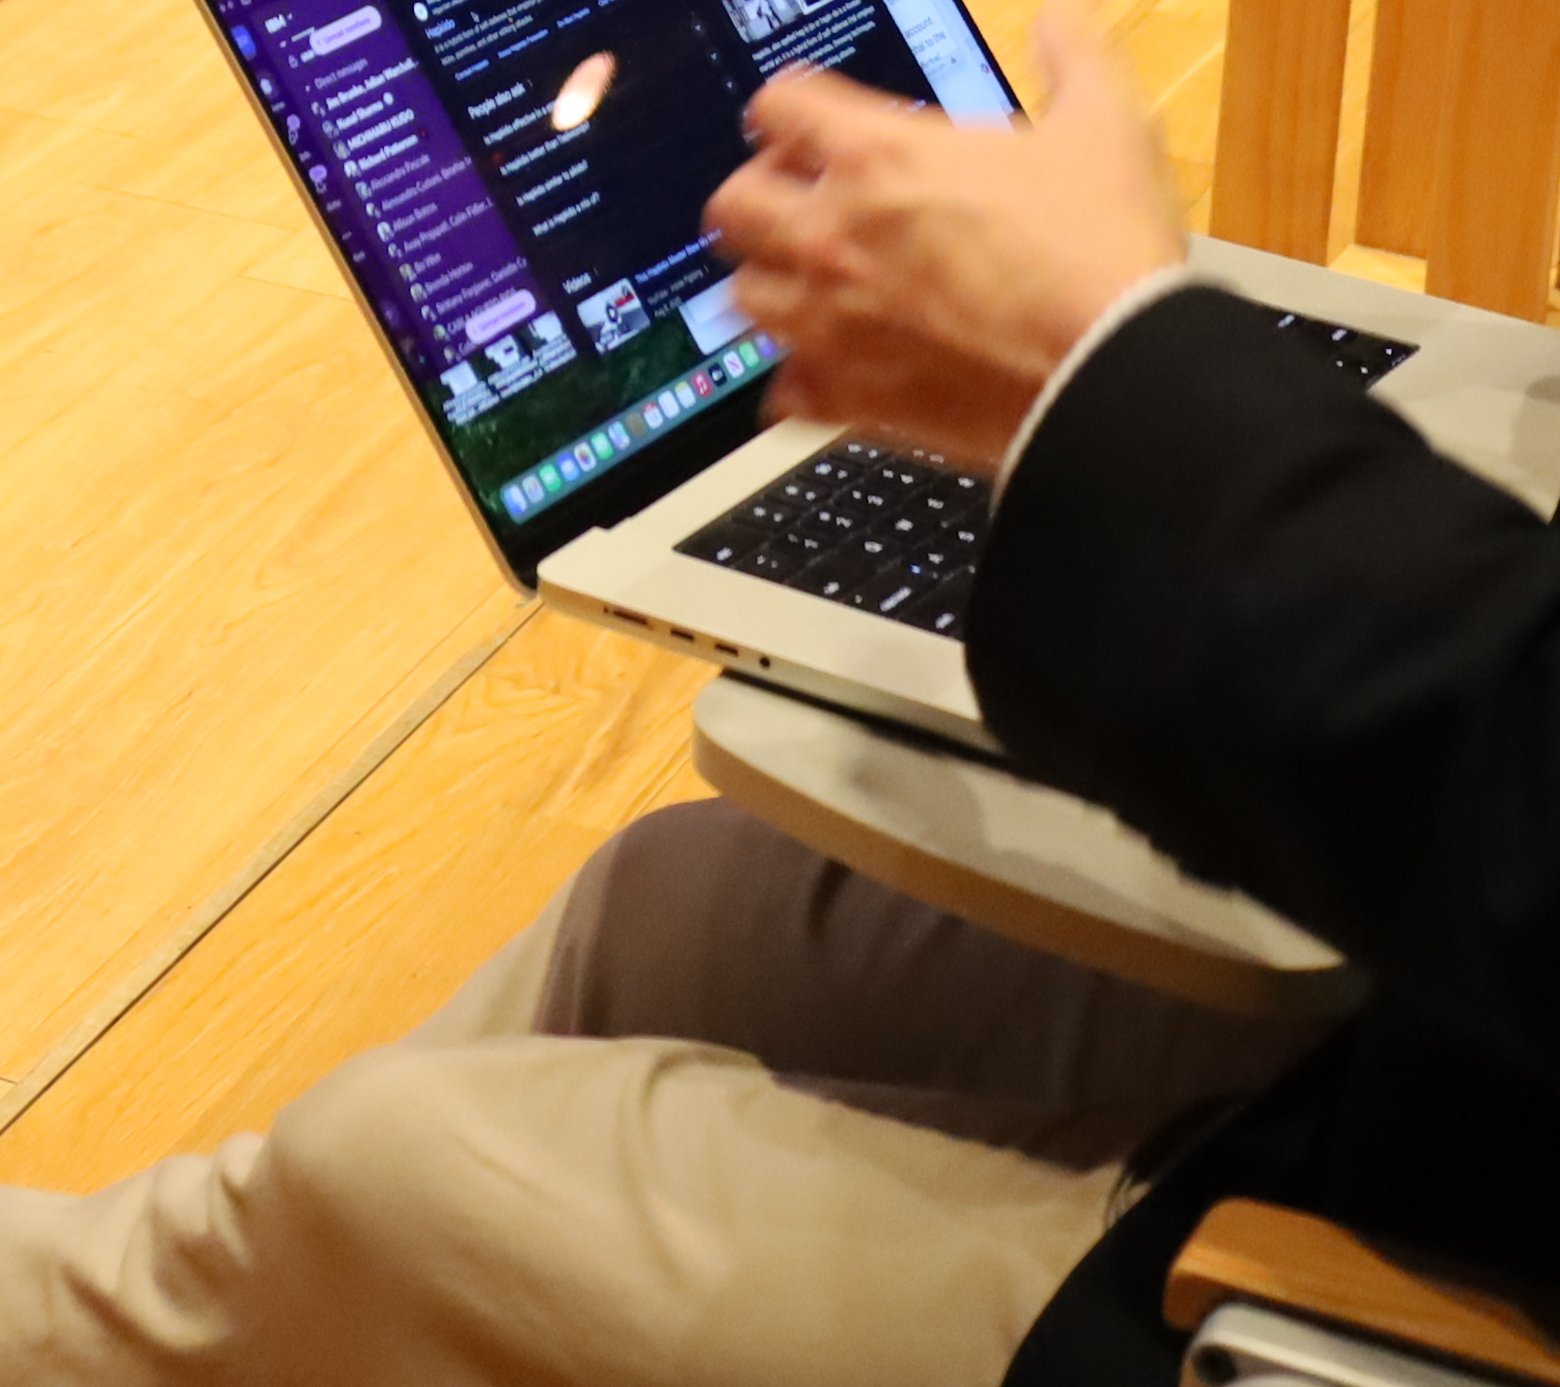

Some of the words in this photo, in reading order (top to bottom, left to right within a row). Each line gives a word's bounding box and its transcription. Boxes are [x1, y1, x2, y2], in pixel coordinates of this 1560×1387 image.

[264, 14, 286, 33] IBM
[424, 18, 456, 39] Hapkido
[467, 97, 497, 119] People
[493, 90, 512, 106] also
[509, 81, 526, 98] ask
[388, 108, 414, 128] KUDO
[488, 124, 514, 142] Hapkido
[511, 111, 537, 131] effective
[504, 153, 531, 172] Hapkido
[526, 144, 546, 161] better
[543, 138, 559, 152] than
[521, 183, 547, 202] Hapkido
[543, 174, 563, 191] similar
[531, 220, 550, 236] What
[552, 205, 578, 224] Hapkido
[562, 272, 592, 294] Videos
